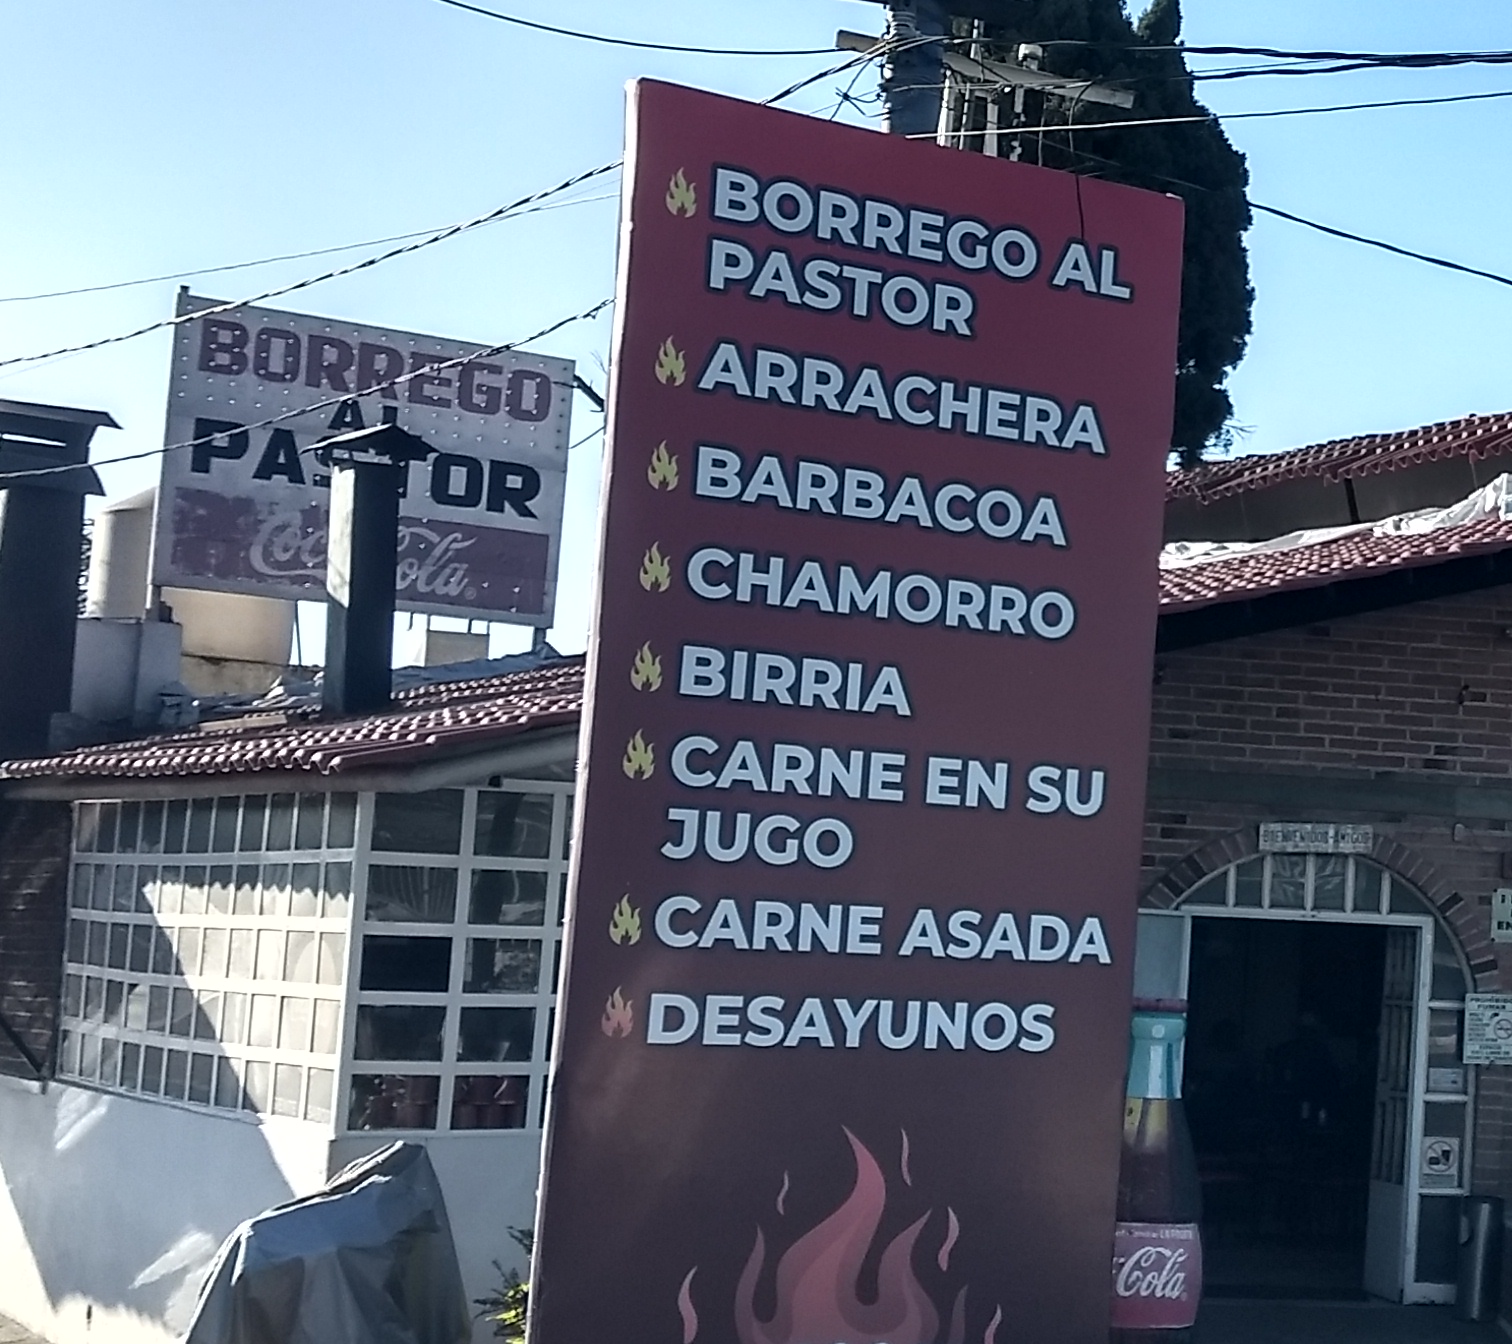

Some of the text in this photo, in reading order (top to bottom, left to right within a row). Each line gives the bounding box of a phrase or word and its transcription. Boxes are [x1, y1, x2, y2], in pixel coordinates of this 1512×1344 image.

[712, 167, 1132, 300] BORREGO AL
[708, 238, 974, 337] PASTOR
[198, 317, 552, 423] BORREGO
[698, 342, 1106, 455] ARRACHERA
[695, 445, 1067, 547] BARBACOA
[686, 547, 1075, 640] CHAMORRO
[678, 644, 912, 717] BIRRIA
[669, 734, 1105, 817] CARNE EN SU
[659, 807, 854, 869] JUGO
[653, 894, 1112, 965] CARNE ASADA
[645, 991, 1056, 1053] DESAYUNOS
